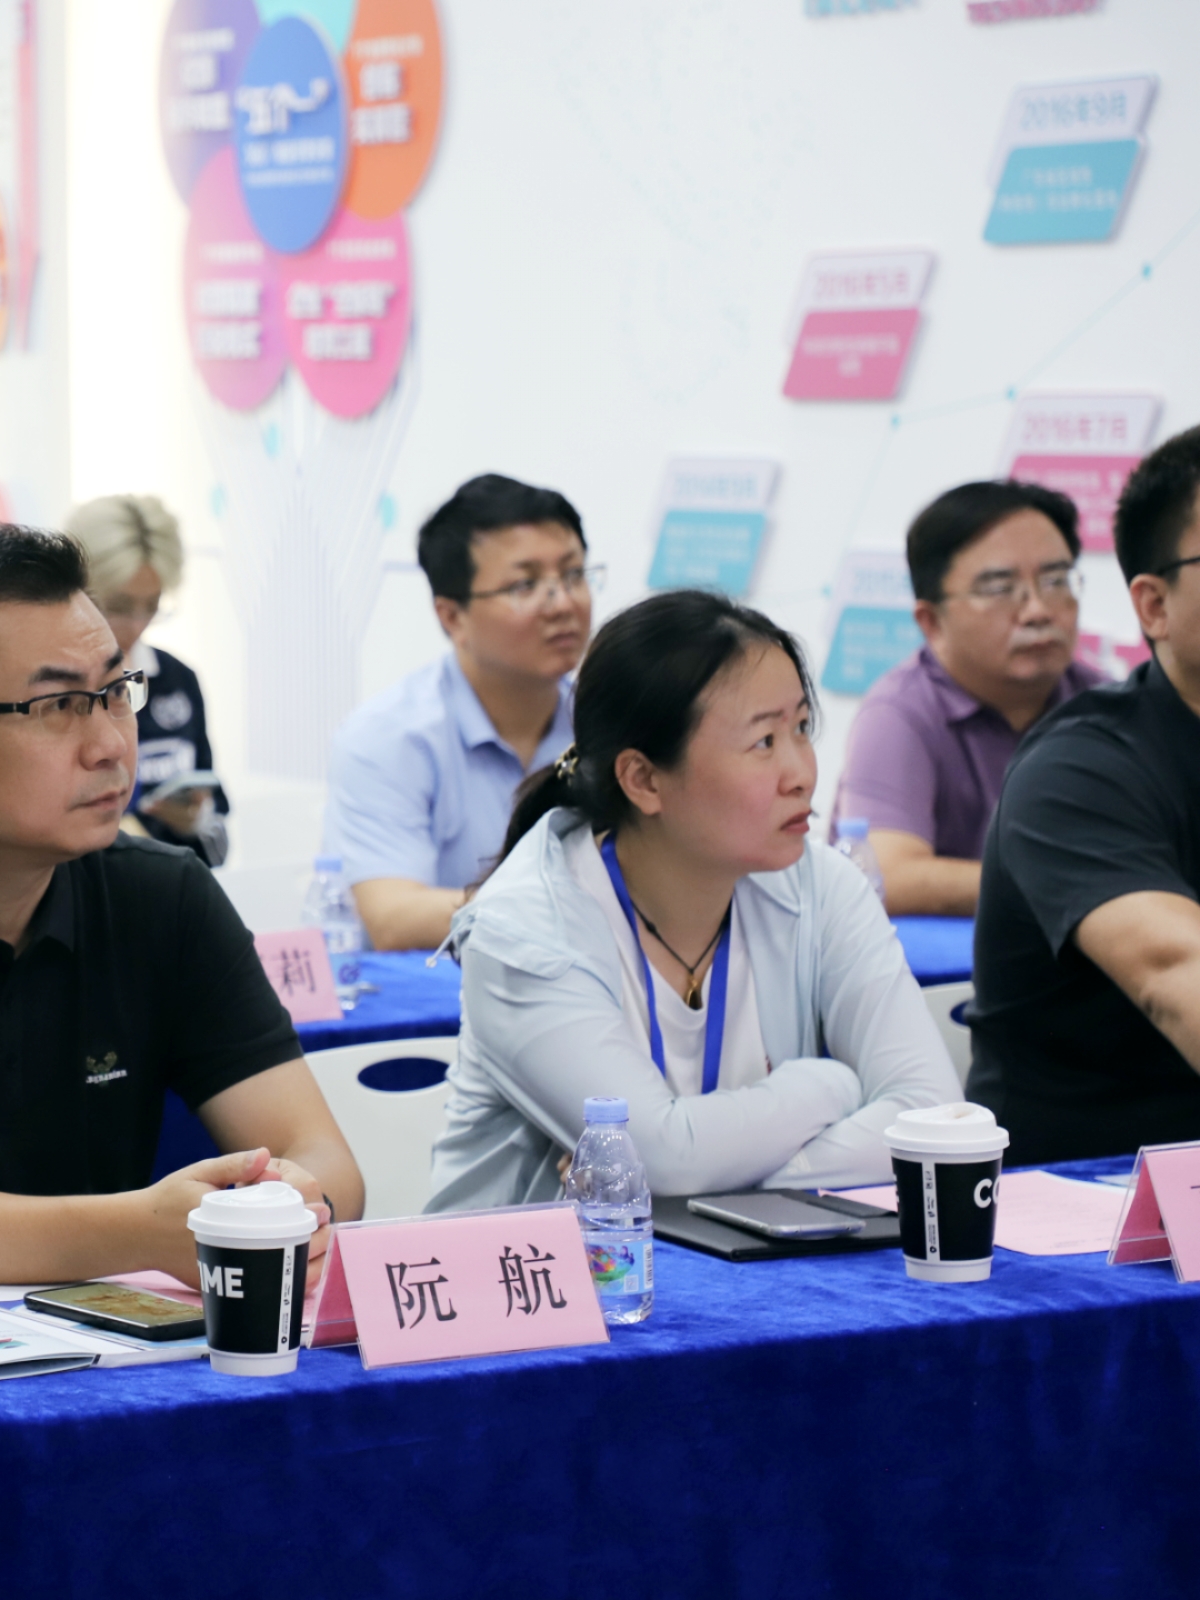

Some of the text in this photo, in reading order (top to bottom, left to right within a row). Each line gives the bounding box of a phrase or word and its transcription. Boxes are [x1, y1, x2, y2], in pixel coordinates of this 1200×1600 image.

[261, 947, 317, 997] 莉
[197, 1259, 245, 1299] IME
[384, 1242, 568, 1330] 阮航
